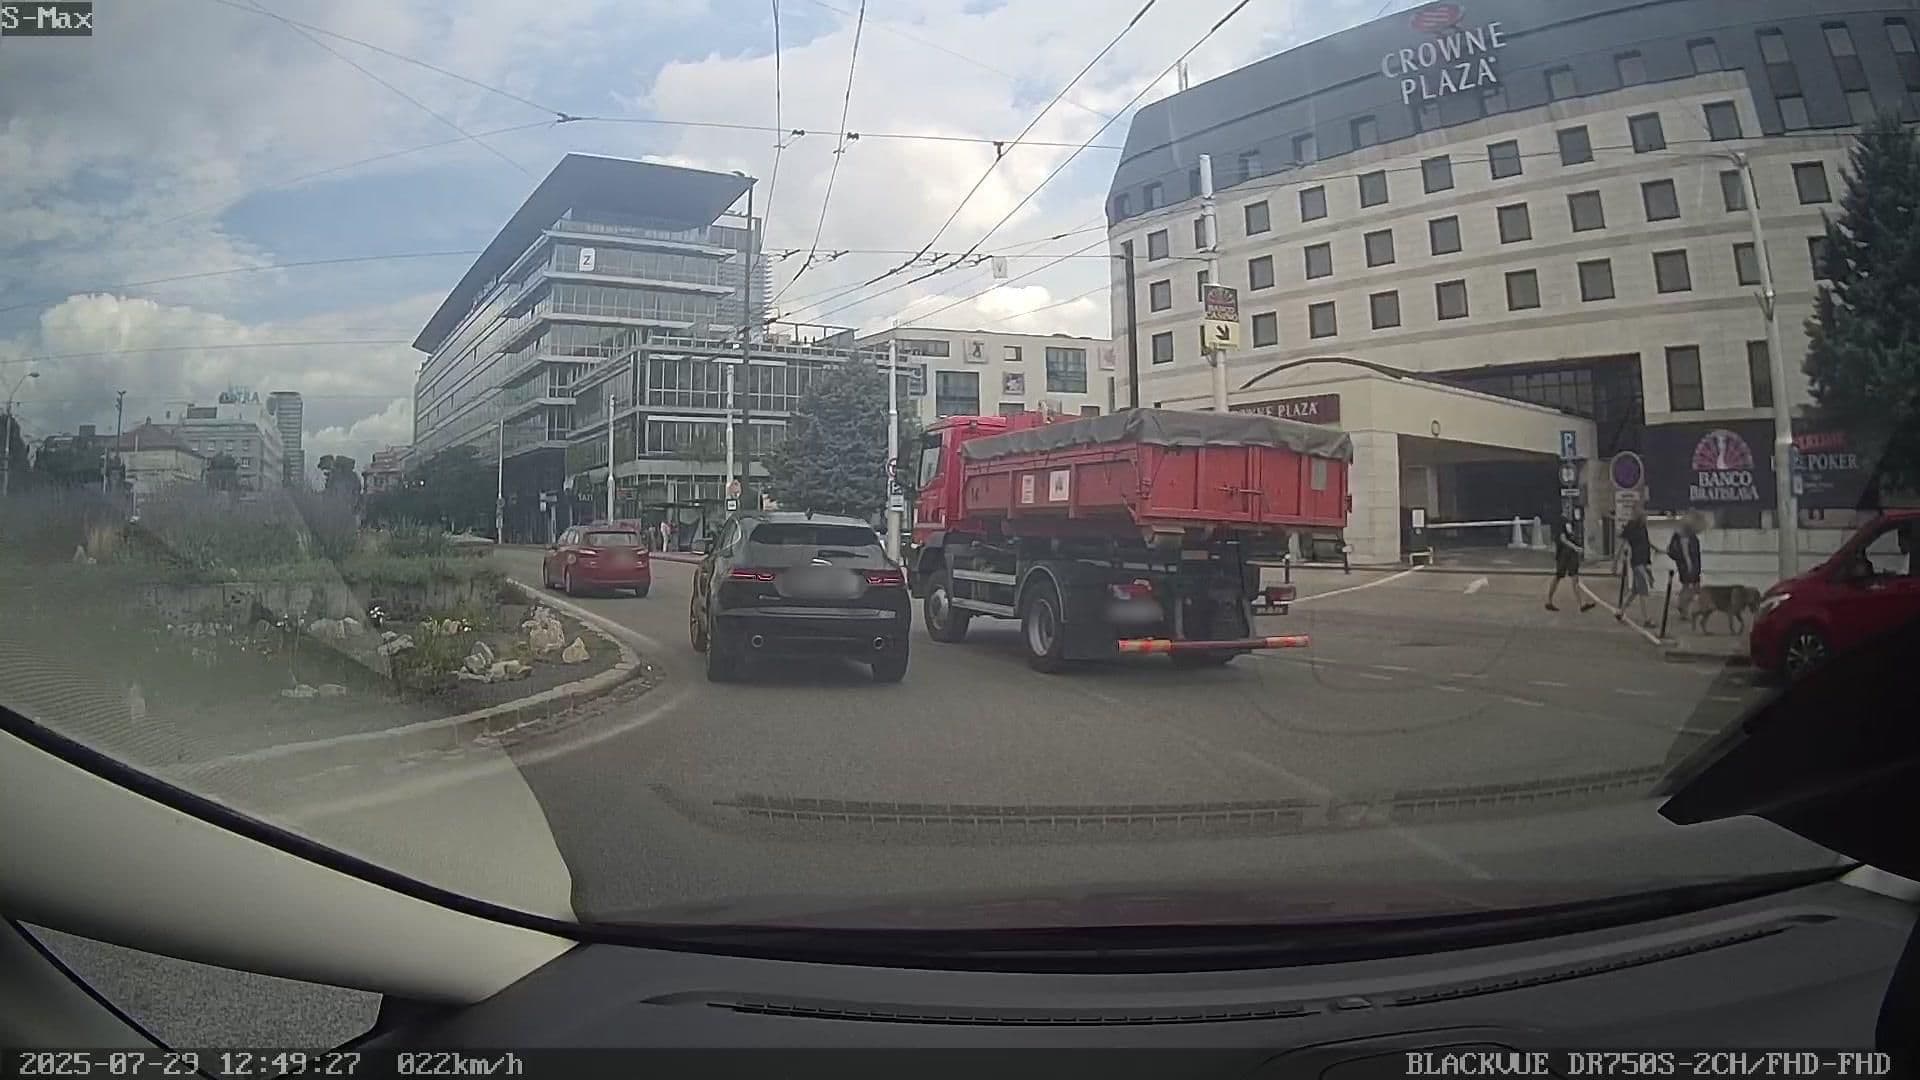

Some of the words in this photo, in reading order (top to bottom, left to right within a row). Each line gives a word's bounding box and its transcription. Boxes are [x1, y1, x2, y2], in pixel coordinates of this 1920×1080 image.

[1382, 22, 1507, 78] CROWNE
[1277, 401, 1318, 417] PLAZA
[1563, 433, 1573, 451] P
[1808, 454, 1857, 470] POKER
[1698, 470, 1753, 487] BANCO
